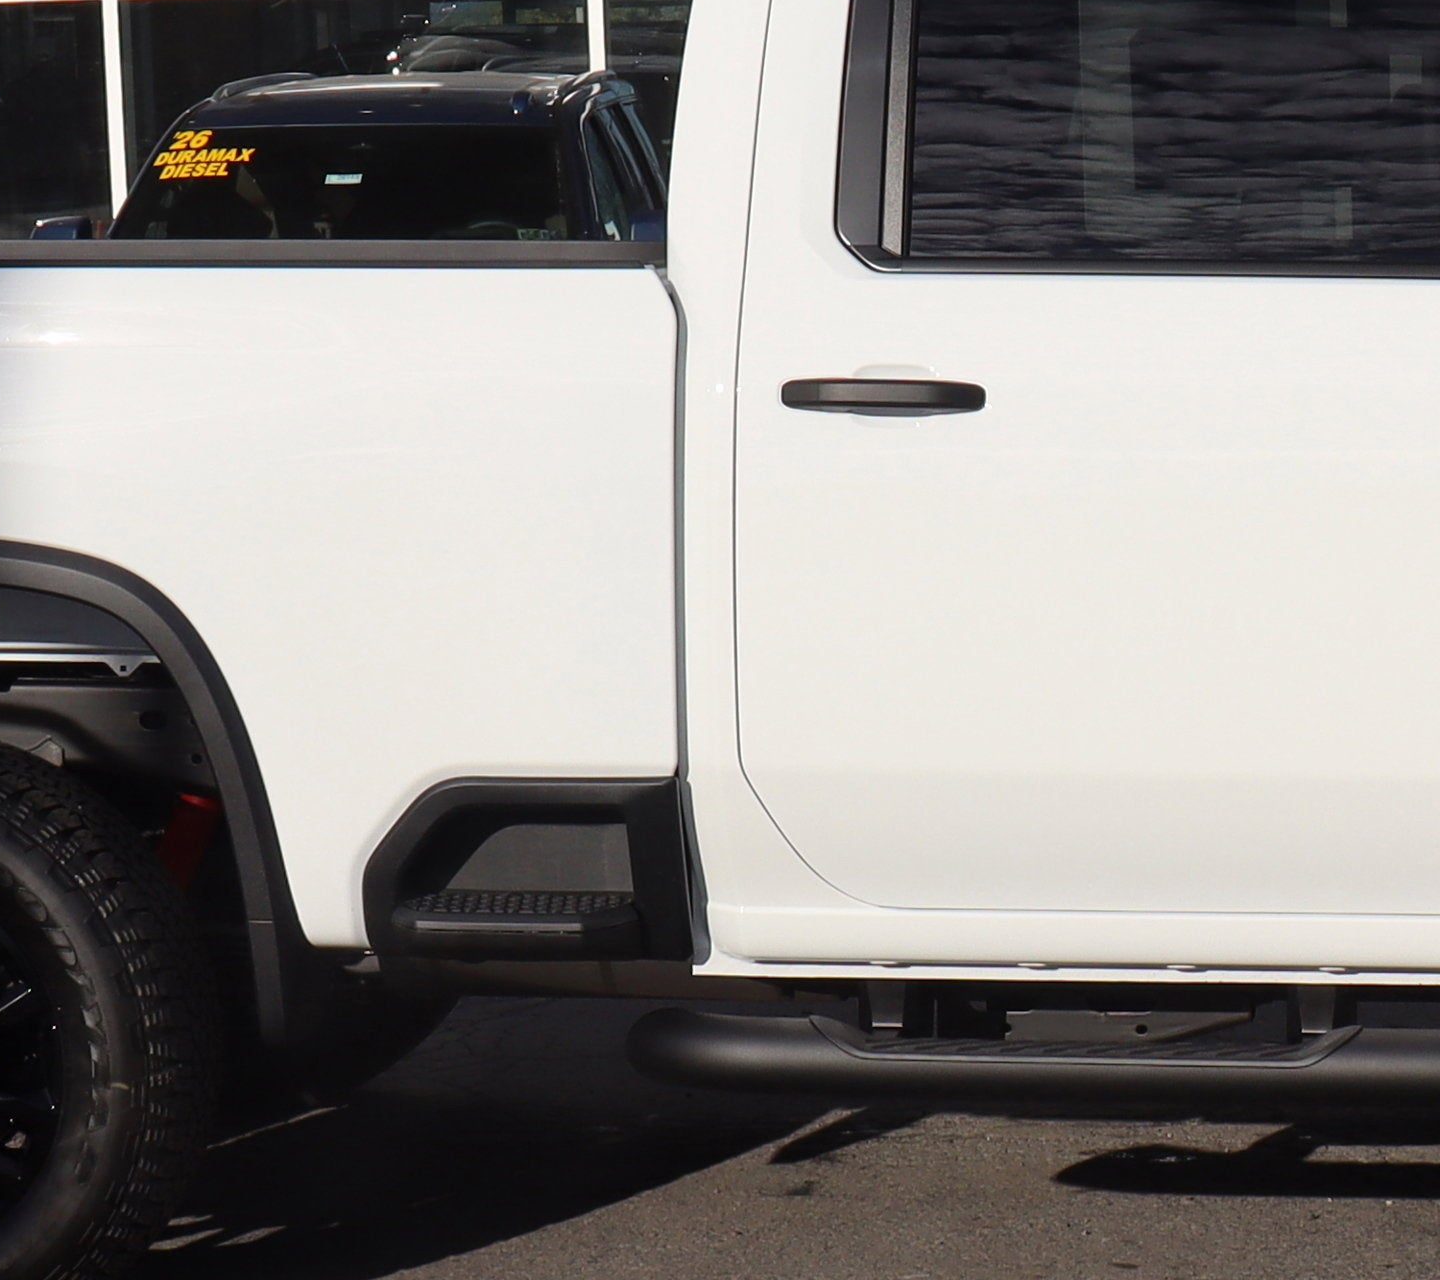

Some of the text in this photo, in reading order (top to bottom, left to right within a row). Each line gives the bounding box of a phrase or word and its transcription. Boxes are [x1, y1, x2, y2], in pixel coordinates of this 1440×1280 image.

[168, 130, 213, 151] '26
[153, 148, 256, 167] DURAMAX
[158, 163, 230, 181] DIESEL
